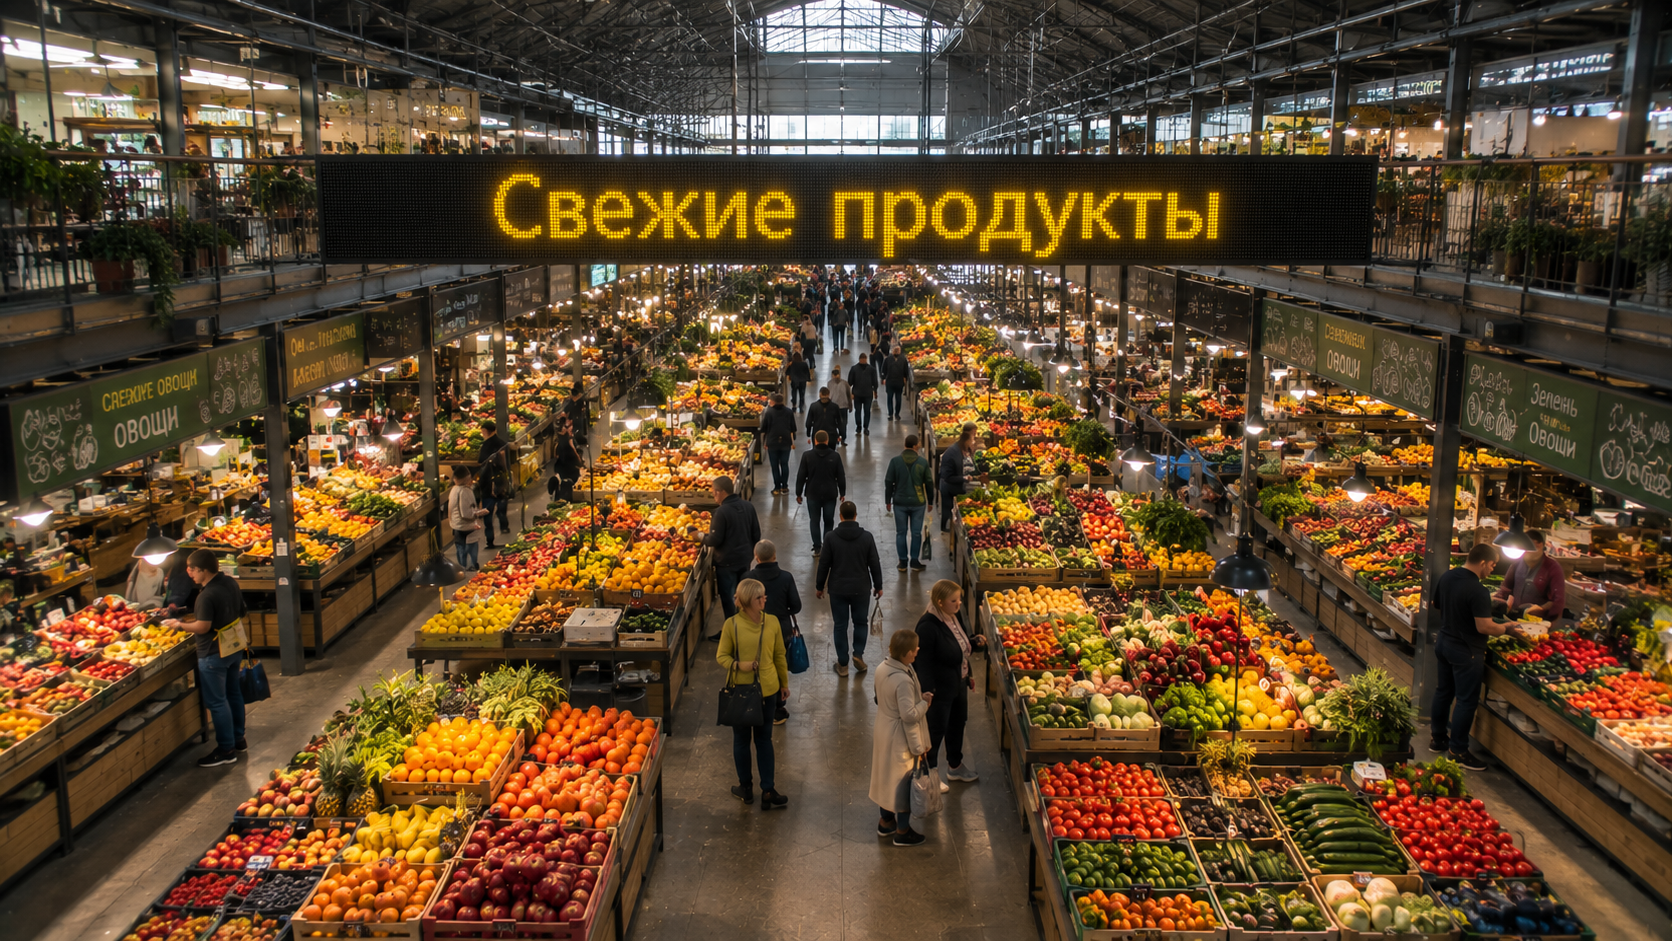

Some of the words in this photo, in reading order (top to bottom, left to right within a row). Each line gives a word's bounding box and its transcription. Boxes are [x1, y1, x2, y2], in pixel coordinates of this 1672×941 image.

[493, 174, 796, 239] Свежие
[832, 189, 1220, 258] продукты
[114, 405, 180, 448] ОВОЩИ
[1529, 421, 1577, 460] Овощи
